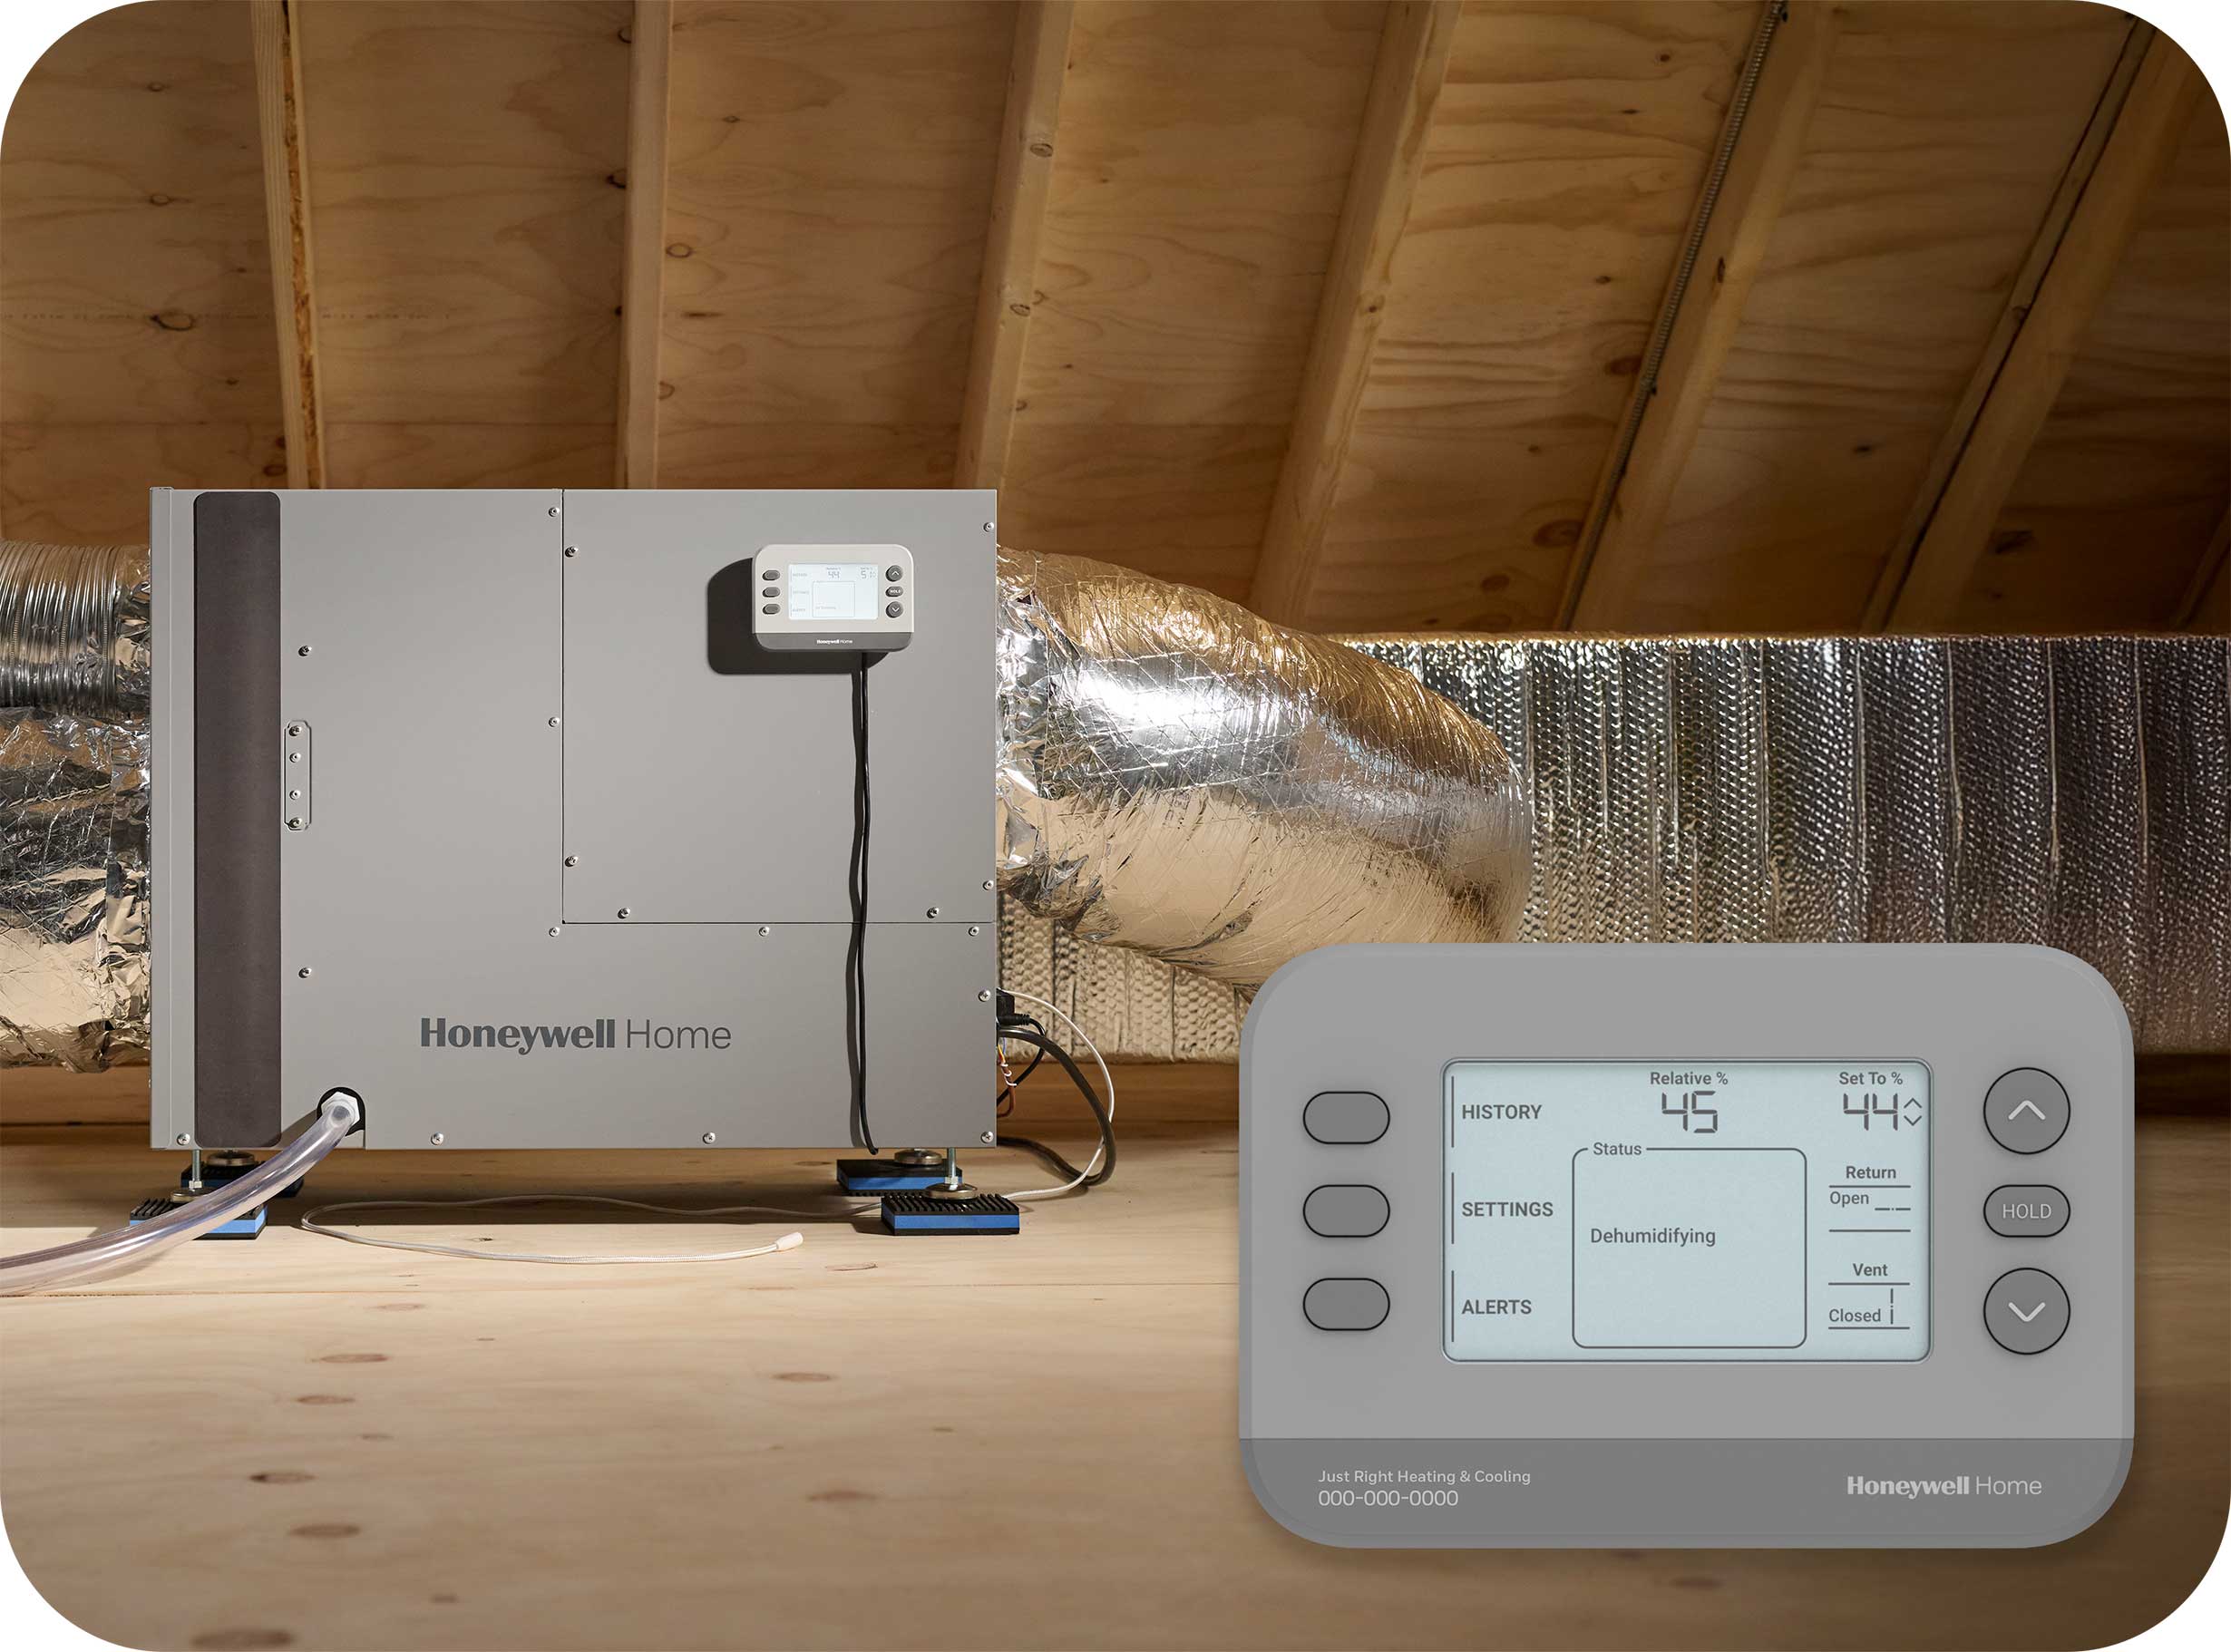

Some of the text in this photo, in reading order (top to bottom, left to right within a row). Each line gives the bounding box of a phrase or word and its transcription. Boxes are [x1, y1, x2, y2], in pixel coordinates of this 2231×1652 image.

[827, 570, 840, 579] 44
[422, 1017, 732, 1056] Honeywell Home
[1650, 1071, 1729, 1086] Relative %
[1838, 1071, 1904, 1085] Set To %
[1461, 1103, 1543, 1120] HISTORY
[1661, 1090, 1719, 1134] 45
[1843, 1093, 1899, 1132] 44
[1593, 1142, 1642, 1156] Status
[1846, 1165, 1897, 1180] Return
[1829, 1190, 1869, 1209] Open
[1461, 1201, 1554, 1218] SETTINGS
[2002, 1203, 2052, 1220] HOLD
[1591, 1227, 1716, 1248] Dehumidifying
[1852, 1262, 1888, 1277] Vent
[1461, 1298, 1532, 1315] ALERTS
[1828, 1307, 1882, 1323] Closed
[1318, 1470, 1531, 1485] Just Right Heating & Cooling
[1847, 1475, 2042, 1500] Honeywell Home
[1318, 1490, 1459, 1506] 000-000-0000
